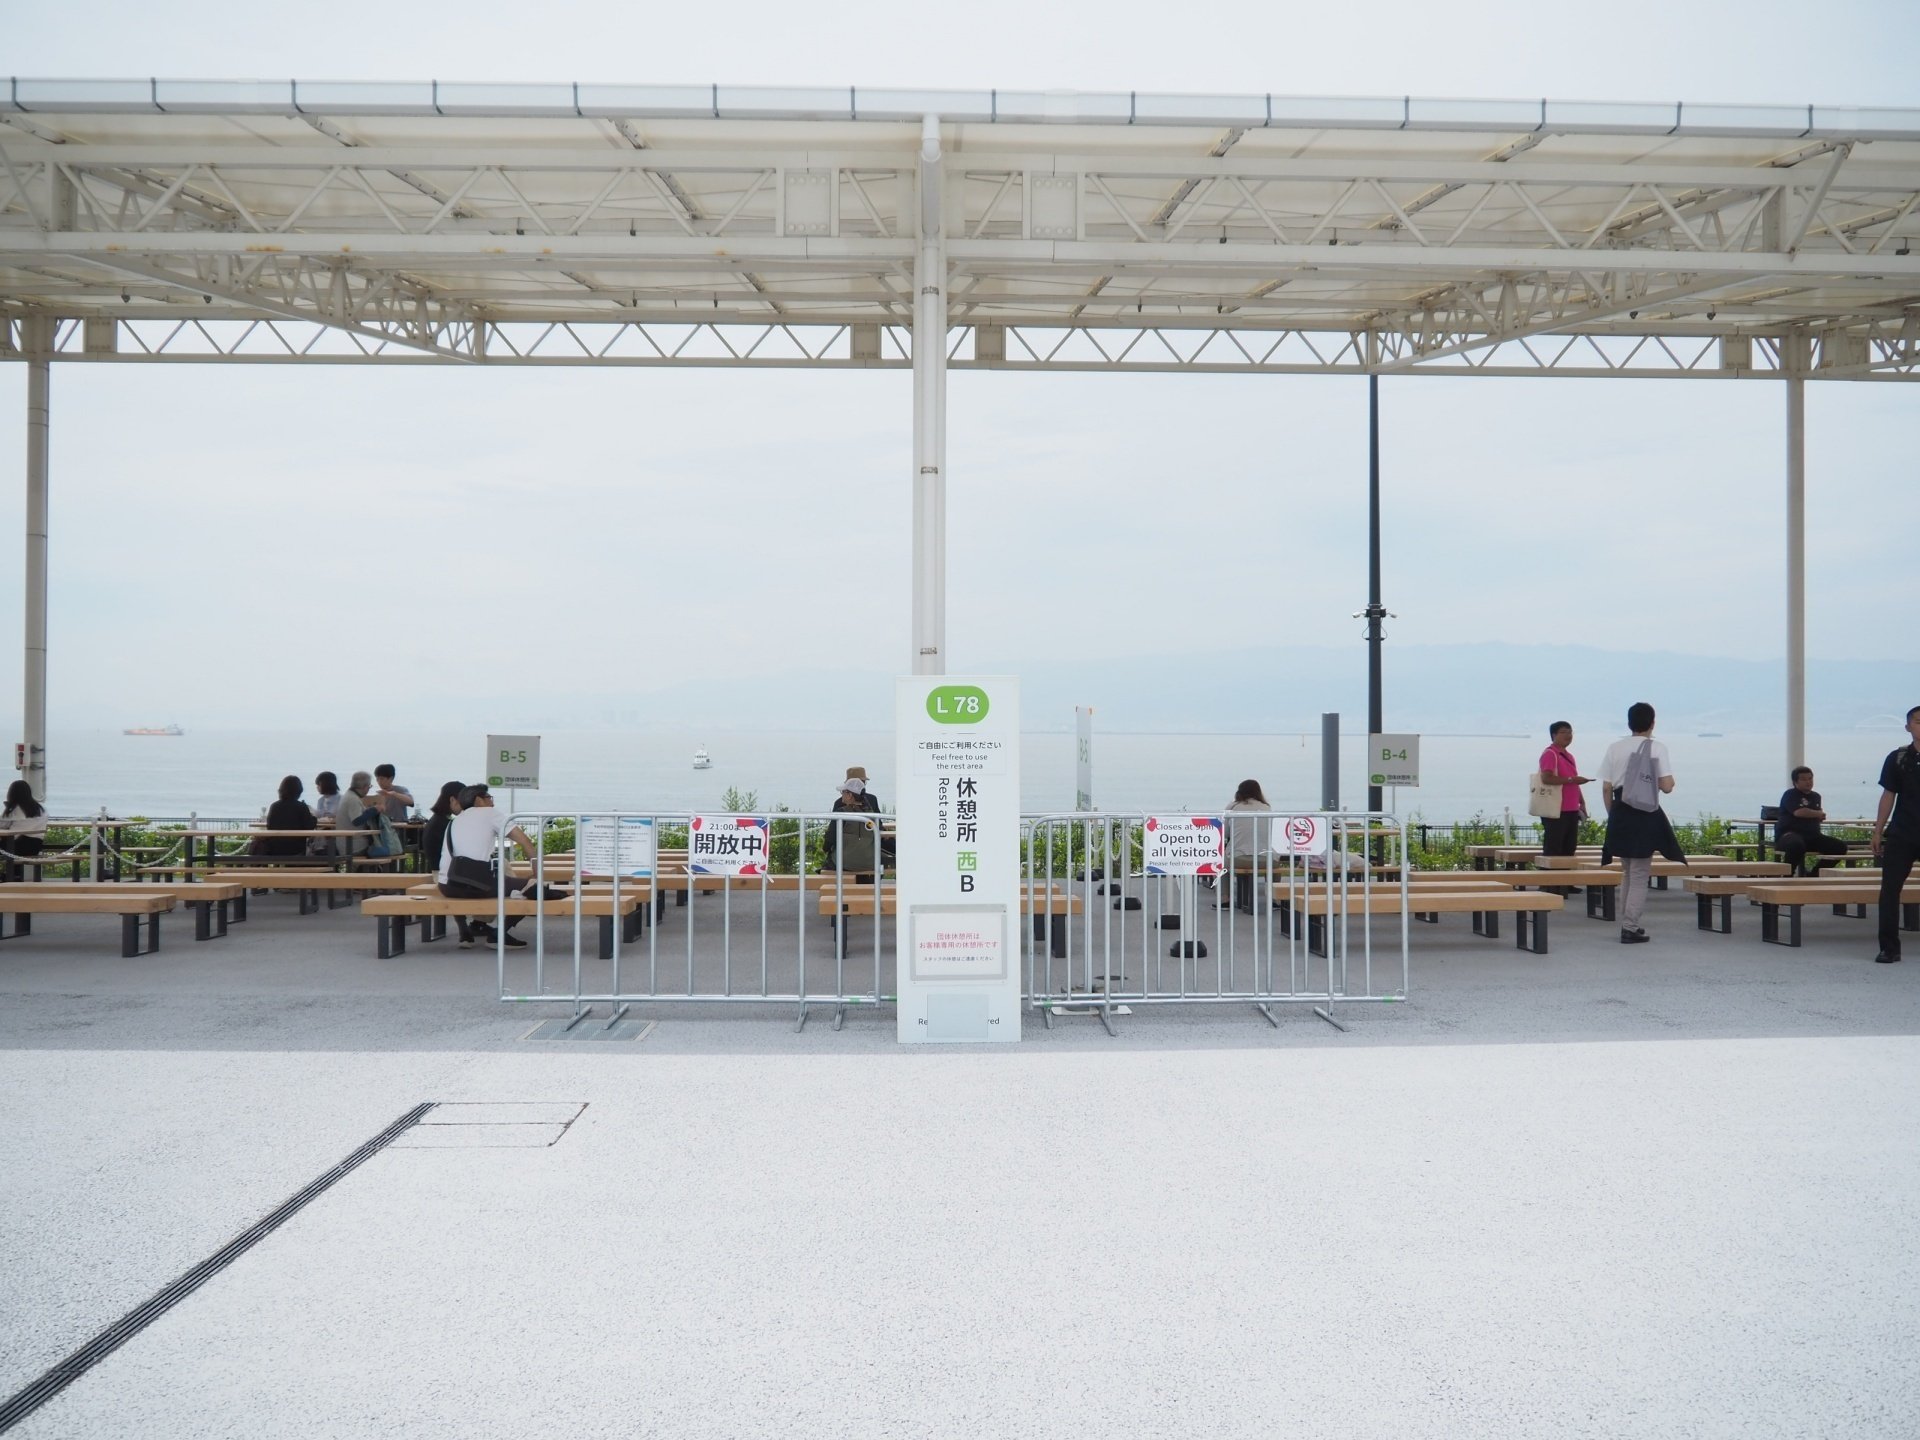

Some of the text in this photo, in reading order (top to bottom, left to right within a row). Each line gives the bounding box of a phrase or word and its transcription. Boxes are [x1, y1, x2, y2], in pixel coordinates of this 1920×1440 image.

[936, 696, 980, 714] L 78
[918, 741, 1002, 750] ご自由にご利用ください
[500, 750, 527, 763] B-5
[931, 753, 947, 761] Feel
[949, 753, 964, 761] free
[1382, 748, 1408, 761] B-4
[936, 762, 949, 770] the
[951, 762, 966, 770] rest
[938, 777, 950, 838] Rest area
[1156, 823, 1182, 831] Closes
[956, 777, 978, 893] 休憩所 西 B
[1159, 833, 1211, 846] Open to
[694, 833, 762, 856] 開放中
[1151, 846, 1219, 858] all visitors
